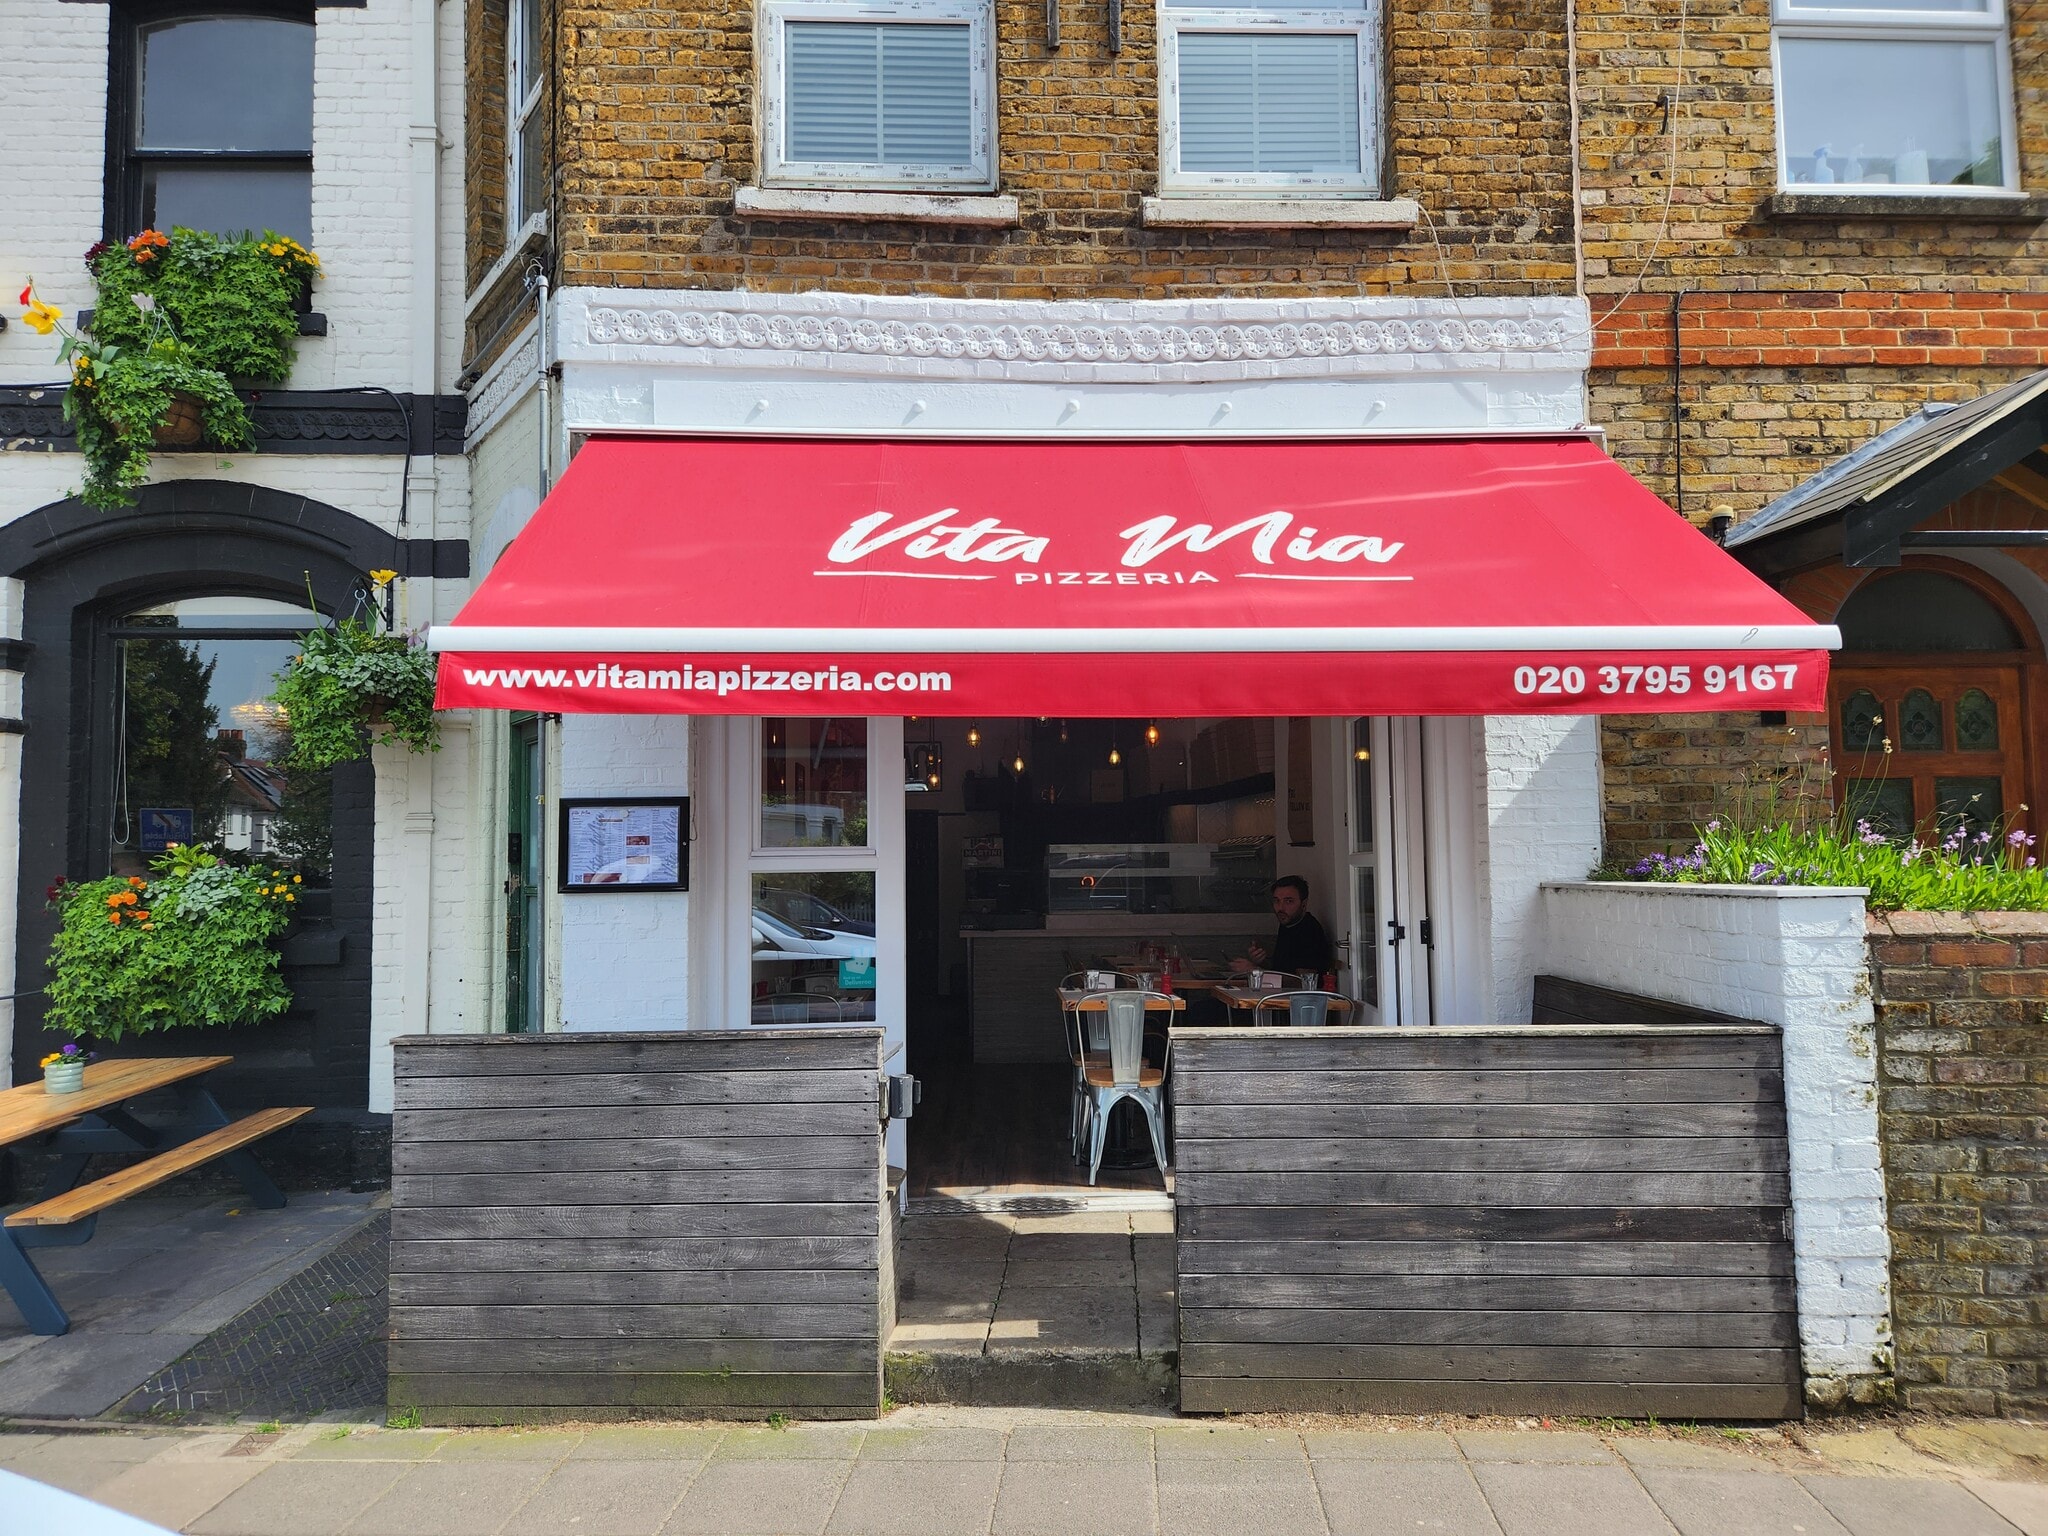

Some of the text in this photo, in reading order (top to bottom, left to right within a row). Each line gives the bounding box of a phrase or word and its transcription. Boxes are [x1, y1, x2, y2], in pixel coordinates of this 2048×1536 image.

[828, 508, 1405, 567] Vita Mia
[1015, 571, 1218, 585] PIZZERIA
[463, 664, 952, 696] www.vitamiapizzeria.com
[1515, 665, 1798, 694] 020 3795 9167
[964, 848, 1001, 857] MARTINI
